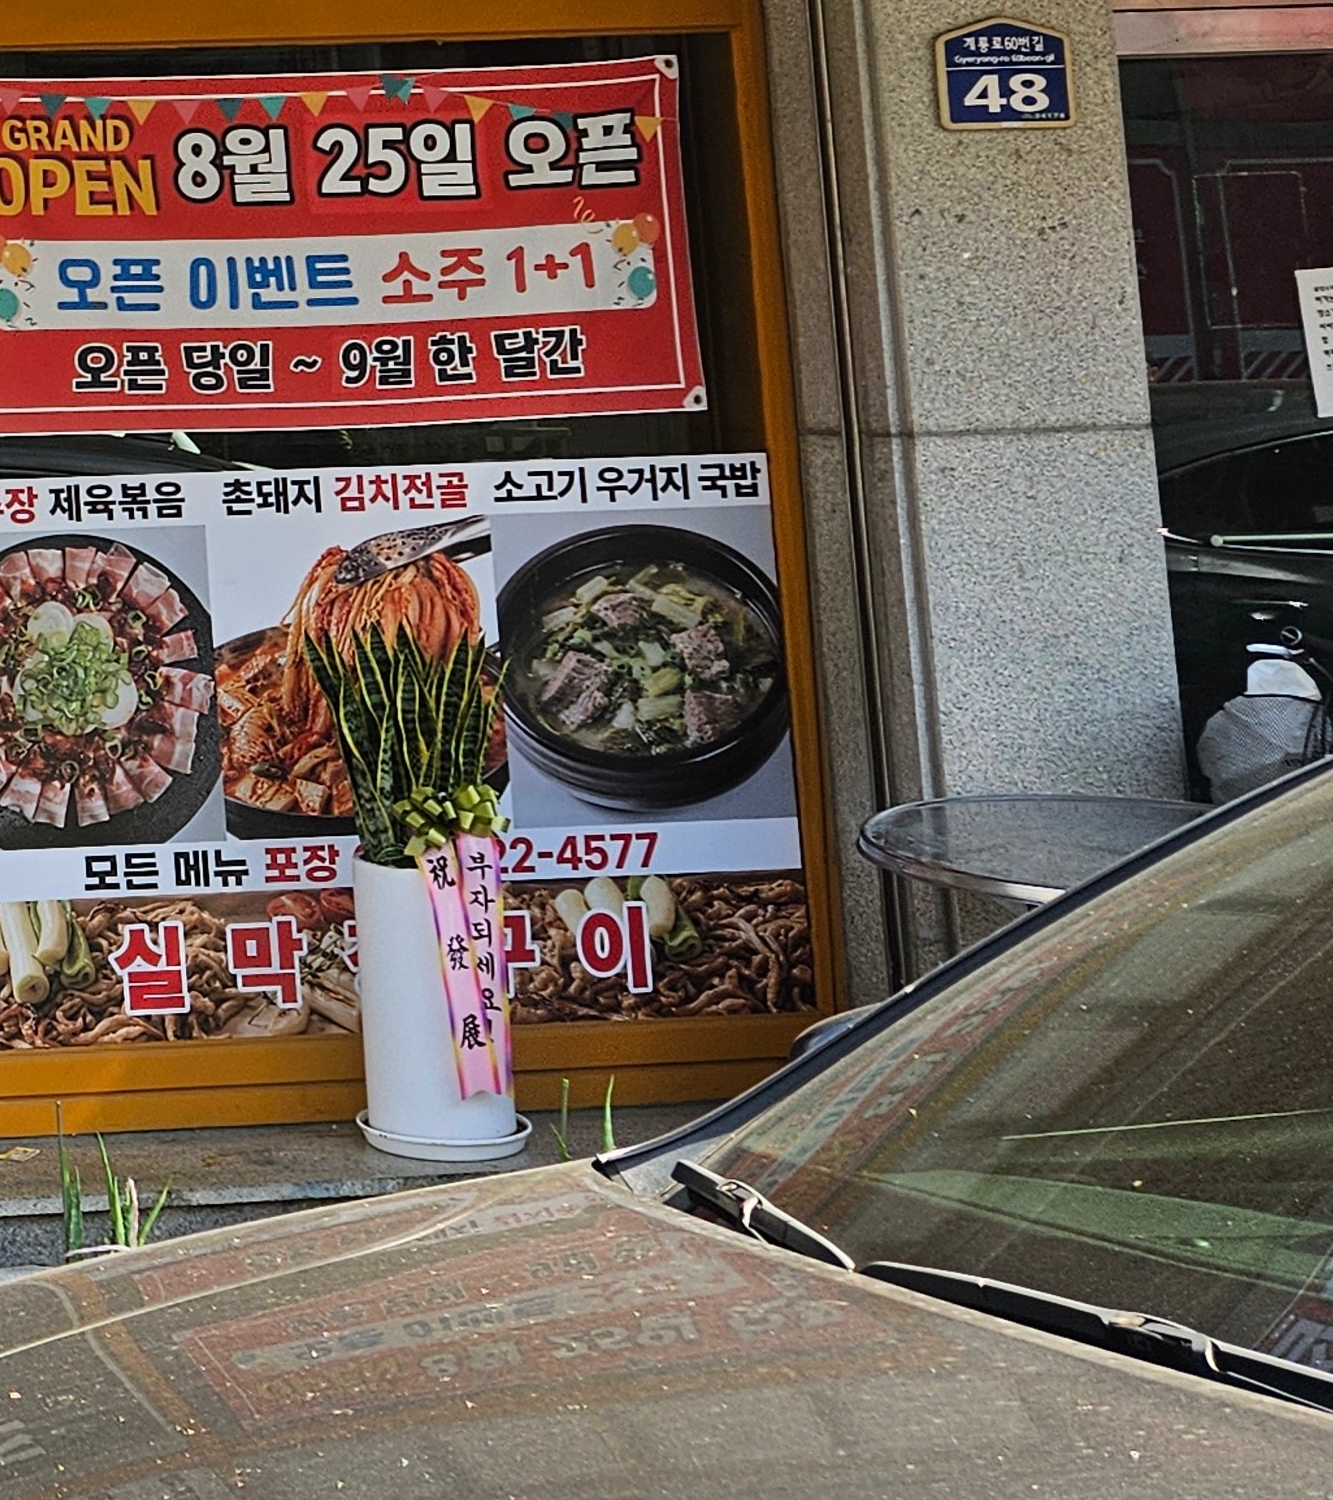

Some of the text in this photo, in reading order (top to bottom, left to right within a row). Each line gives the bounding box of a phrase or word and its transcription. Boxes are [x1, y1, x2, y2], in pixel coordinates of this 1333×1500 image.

[964, 73, 1050, 113] 48
[1, 118, 131, 153] GRAND
[173, 111, 640, 204] 8월 25일 오픈
[56, 241, 596, 312] 오픈 이벤트 소주 1+1
[73, 341, 167, 394] 오픈
[180, 341, 274, 392] 당일
[341, 338, 415, 388] 9월
[429, 336, 477, 384] 한
[492, 327, 586, 380] 달간
[48, 480, 186, 522] 제육볶음
[221, 472, 468, 516] 촌돼지 김치전골
[493, 461, 761, 506] 소고기 우거지 국밥
[84, 852, 158, 893] 모든
[174, 847, 250, 887] 메뉴
[264, 843, 339, 884] 포장
